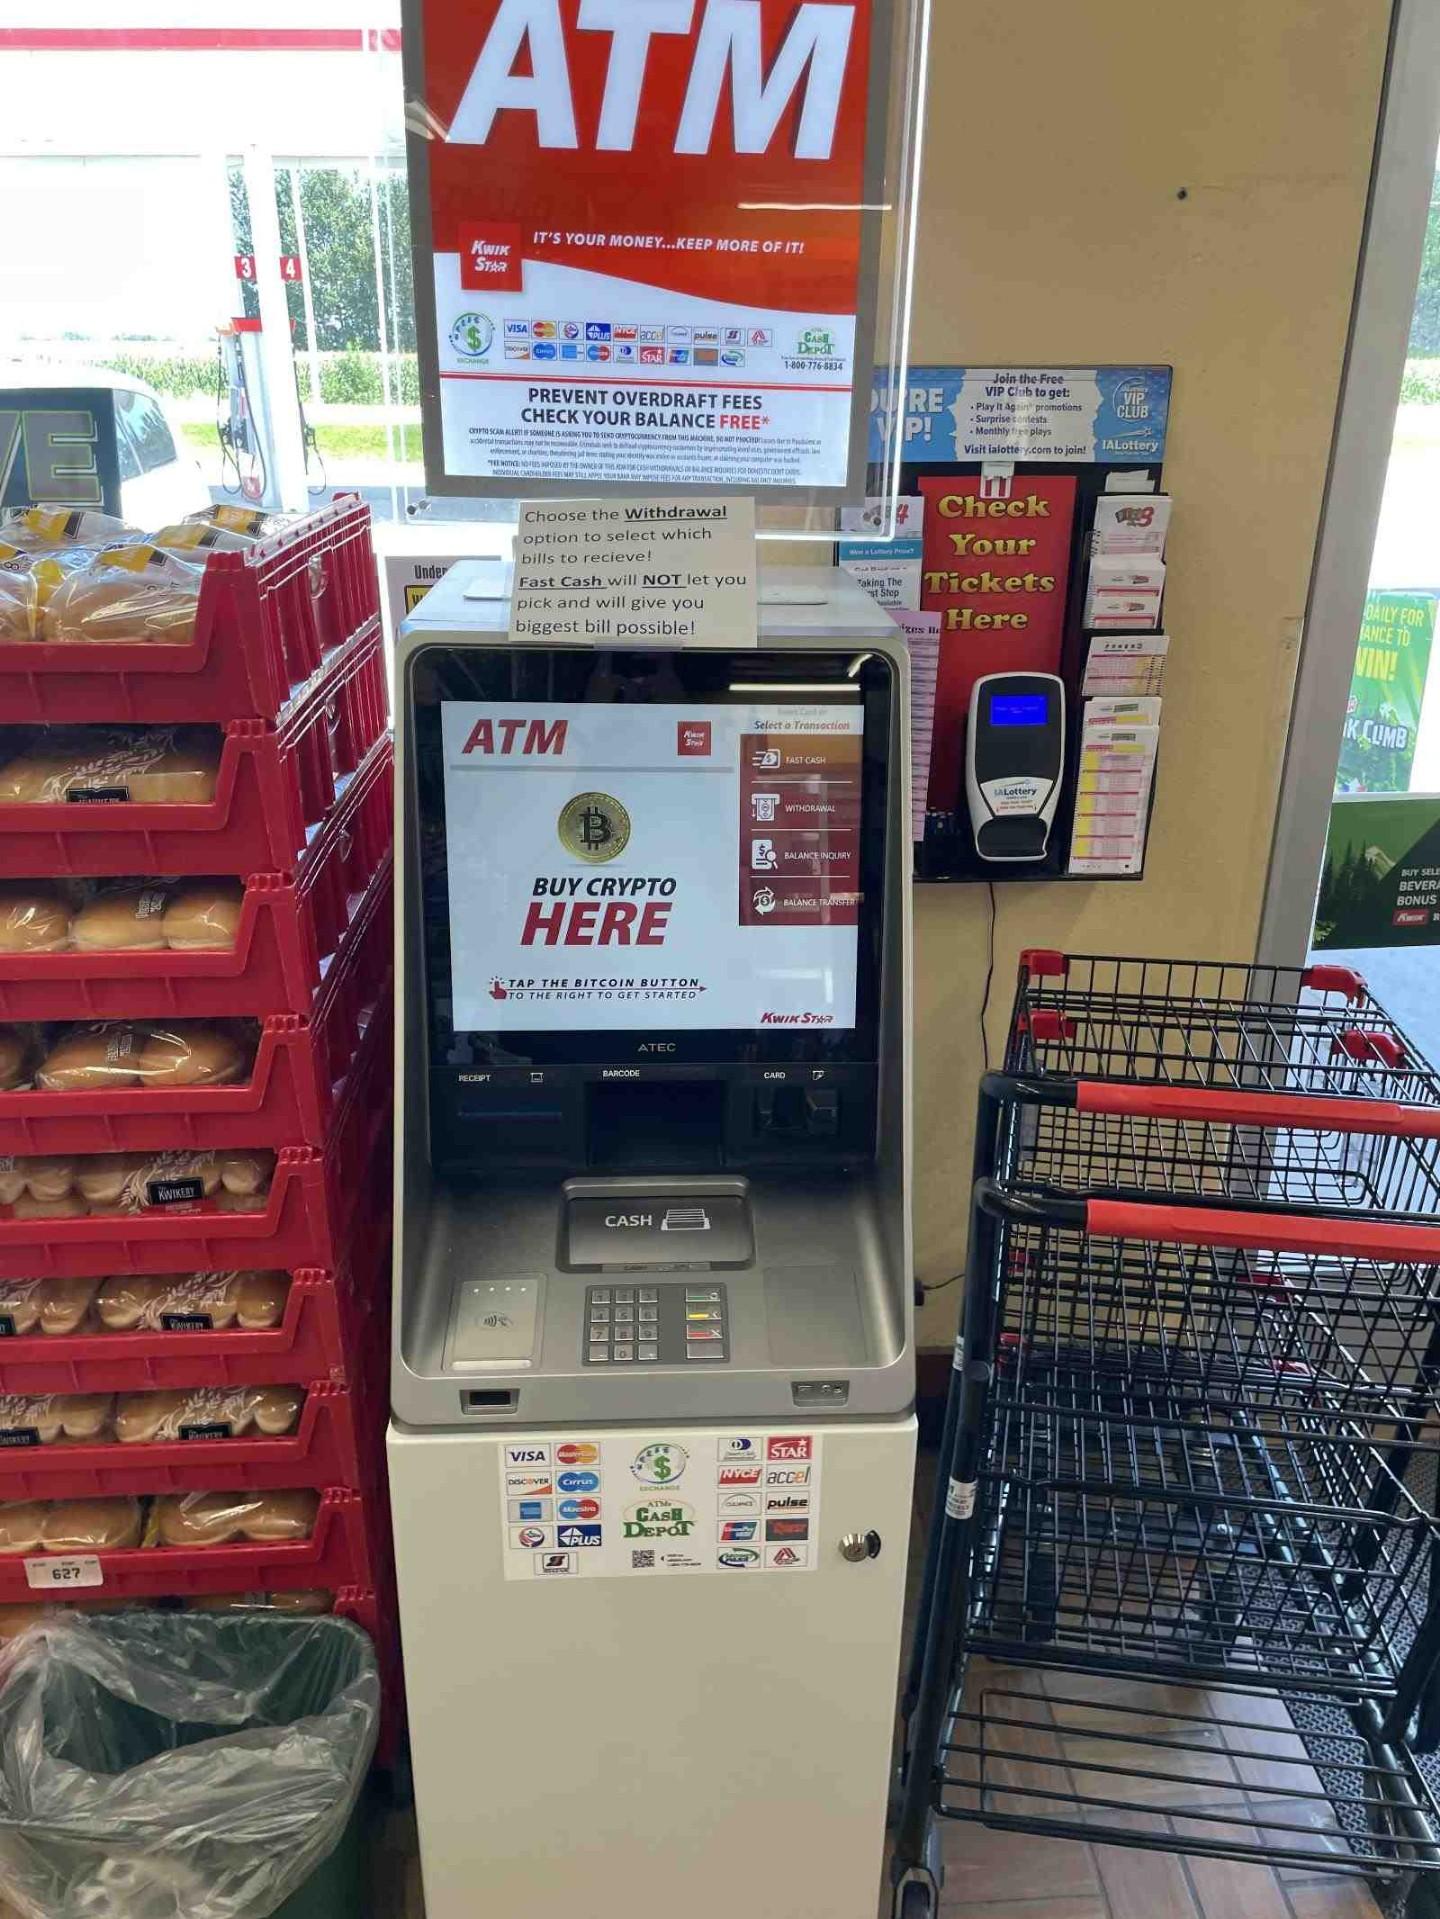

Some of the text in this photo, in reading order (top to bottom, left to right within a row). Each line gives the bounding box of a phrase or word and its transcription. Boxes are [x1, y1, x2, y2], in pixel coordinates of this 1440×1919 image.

[445, 0, 855, 159] ATM
[533, 231, 561, 244] IT'S
[566, 232, 606, 246] YOUR
[716, 238, 750, 253] MORE
[762, 240, 781, 254] OF
[784, 241, 804, 254] IT!
[242, 258, 253, 277] 3
[285, 259, 296, 277] 4
[507, 324, 528, 333] VISA
[993, 373, 1064, 384] Join the Free
[528, 387, 763, 411] PREVENT OVERDRAFT FEES
[985, 386, 1070, 400] VIP Club to get:
[1124, 392, 1145, 405] VIP
[976, 402, 995, 412] Play
[1035, 403, 1083, 413] promotions
[1117, 405, 1149, 418] CLUB
[521, 407, 578, 425] CHECK
[583, 409, 631, 427] YOUR
[635, 411, 715, 429] BALANCE
[976, 414, 1011, 424] Surprise
[976, 427, 1011, 437] Monthly
[1030, 427, 1052, 437] plays
[964, 445, 986, 454] Visit
[1054, 446, 1063, 455] to
[1065, 445, 1086, 457] join!
[938, 495, 1051, 519] Check
[525, 505, 728, 524] Choose the Withdrawal
[523, 527, 712, 546] option to select which
[949, 533, 1037, 557] Your
[522, 550, 652, 566] bills to recieve!
[519, 574, 747, 590] Fast Cash will NOT let you
[887, 578, 903, 586] The
[924, 571, 1056, 594] Tickets
[880, 588, 900, 599] Step
[517, 596, 704, 613] pick and will give you
[946, 608, 1029, 632] Here
[1366, 604, 1425, 627] DAILY FOR
[515, 618, 695, 637] biggest bill possible!
[1397, 628, 1411, 647] TO
[755, 720, 850, 730] Select a Transaction
[462, 719, 569, 755] ATM
[1363, 719, 1409, 749] CLIMB
[786, 756, 826, 765] FAST CASH
[785, 804, 836, 813] WITHDRAWAL
[784, 851, 851, 860] BALANCE INQUIRY
[1401, 868, 1419, 877] BUY
[532, 876, 677, 897] BUY CRYPTO
[783, 898, 855, 907] BALANCE TRANSFER
[1396, 894, 1438, 906] BONUS
[520, 901, 673, 946] HERE
[509, 978, 700, 988] TAP THE BITCOIN BUTTON
[509, 991, 697, 1000] TO THE RIGHT TO GET STARTED
[638, 1043, 677, 1053] ATEC
[458, 1074, 491, 1082] RECEIPT
[602, 1069, 641, 1078] BARCODE
[763, 1071, 786, 1079] CARD
[605, 1214, 653, 1228] CASH
[509, 1450, 546, 1462] VISA
[770, 1446, 807, 1458] STAR
[722, 1468, 760, 1479] NYCE
[767, 1466, 811, 1484] accel
[508, 1478, 549, 1486] DISCOVER
[562, 1478, 593, 1486] Cirrus
[767, 1496, 809, 1510] pulse
[636, 1507, 683, 1522] CASH
[622, 1520, 696, 1538] DEPOT
[571, 1535, 601, 1546] PLUS
[52, 1567, 81, 1580] 627
